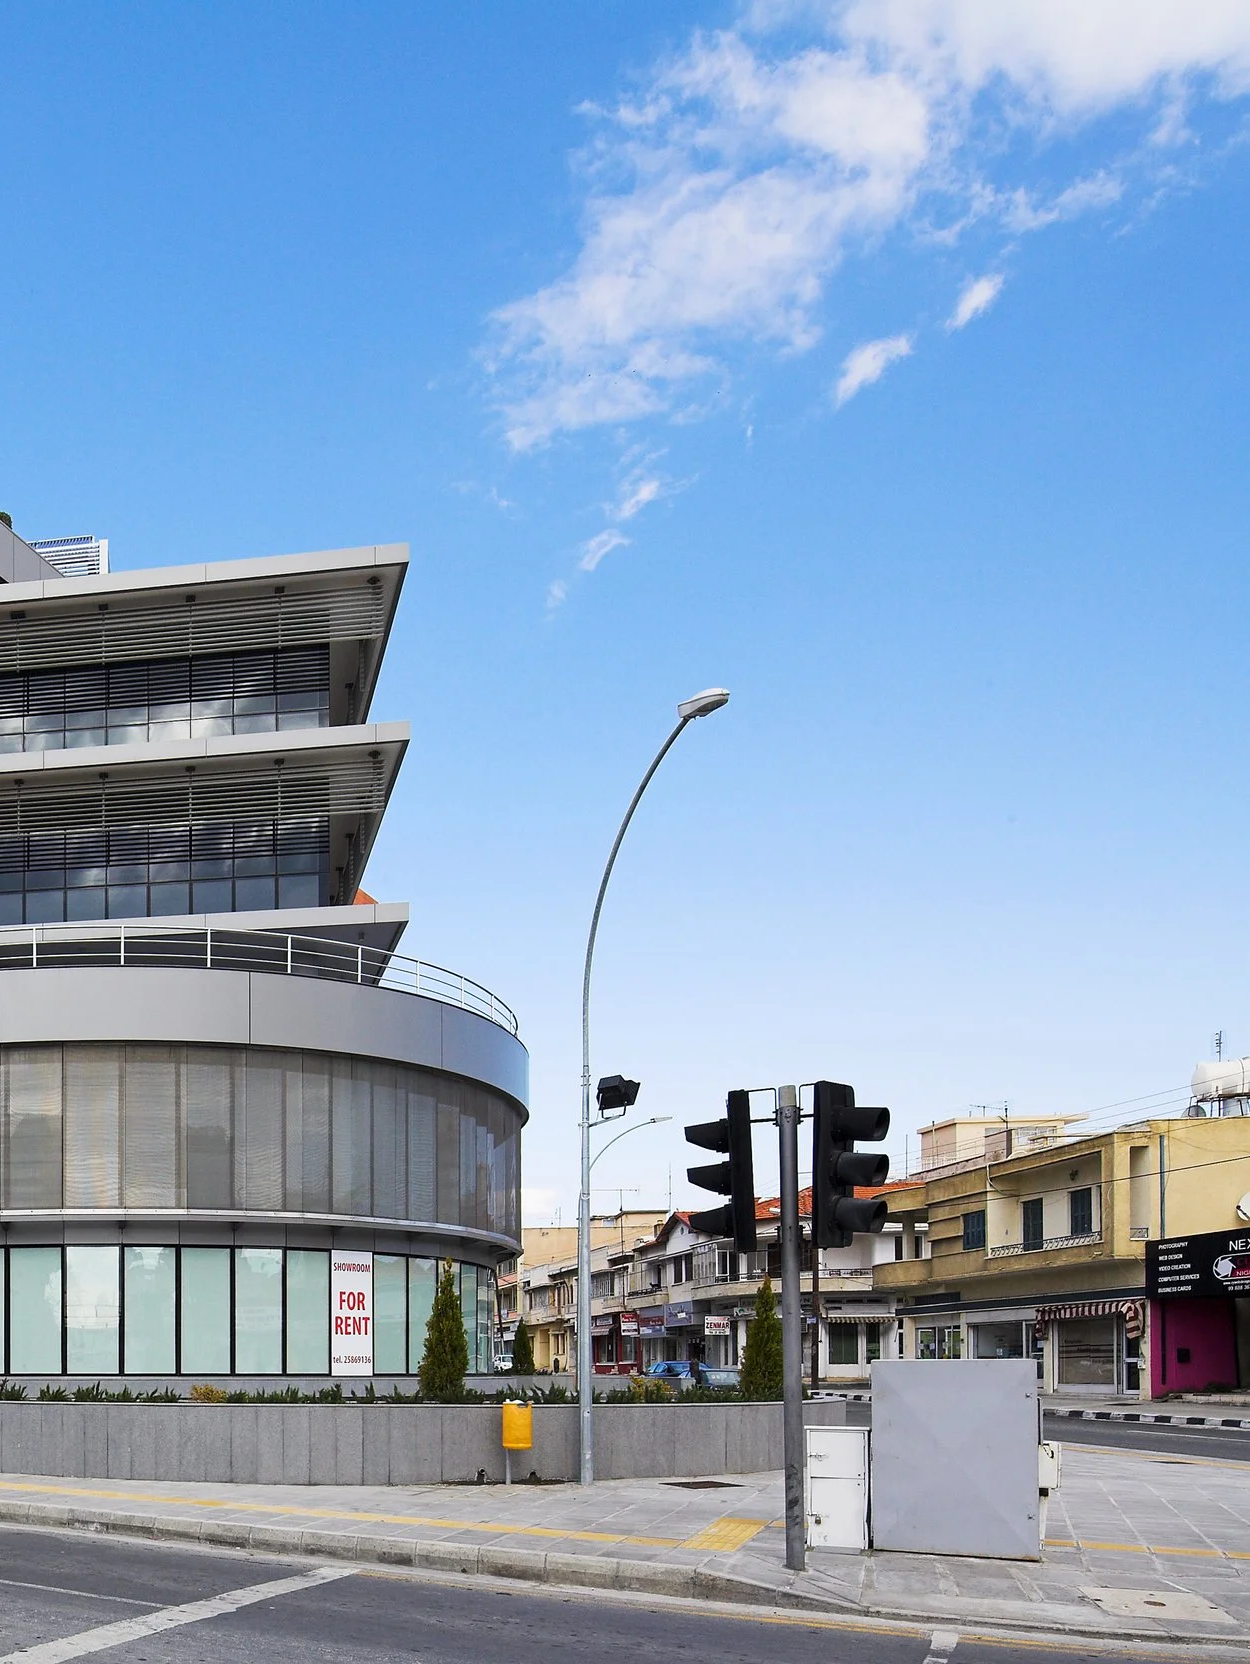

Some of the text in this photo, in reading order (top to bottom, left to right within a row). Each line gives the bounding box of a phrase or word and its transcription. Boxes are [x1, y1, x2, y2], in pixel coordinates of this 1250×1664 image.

[333, 1262, 371, 1273] SHOWROOM
[339, 1291, 366, 1311] FOR
[335, 1316, 370, 1335] RENT
[705, 1321, 730, 1329] ZENMAR
[333, 1356, 343, 1364] tel.
